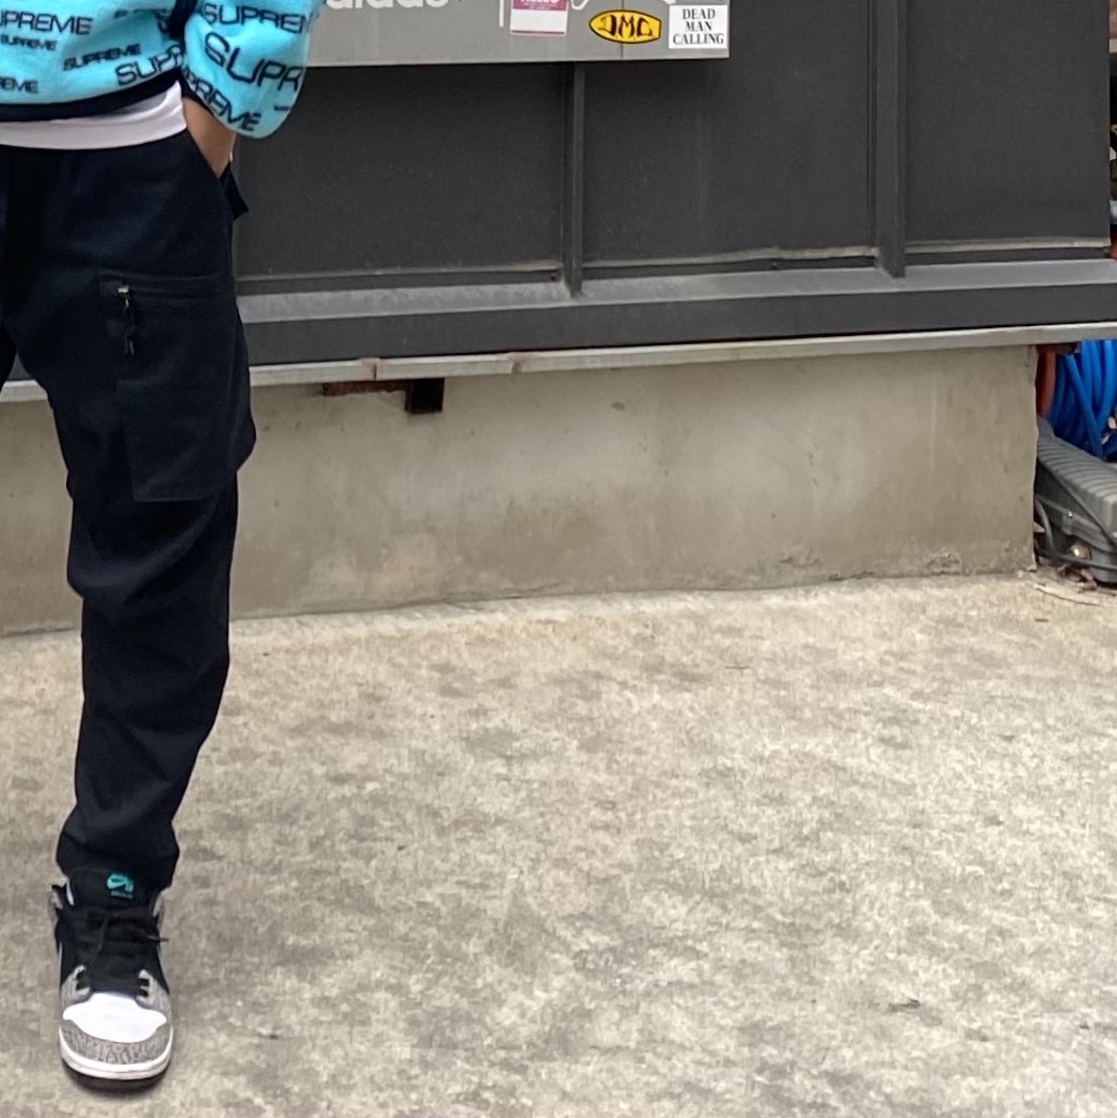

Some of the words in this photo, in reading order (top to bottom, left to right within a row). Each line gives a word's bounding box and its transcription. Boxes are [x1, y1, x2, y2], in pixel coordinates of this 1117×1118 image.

[682, 8, 716, 20] DEAD
[685, 20, 712, 32] MAN
[673, 33, 724, 45] CALLING
